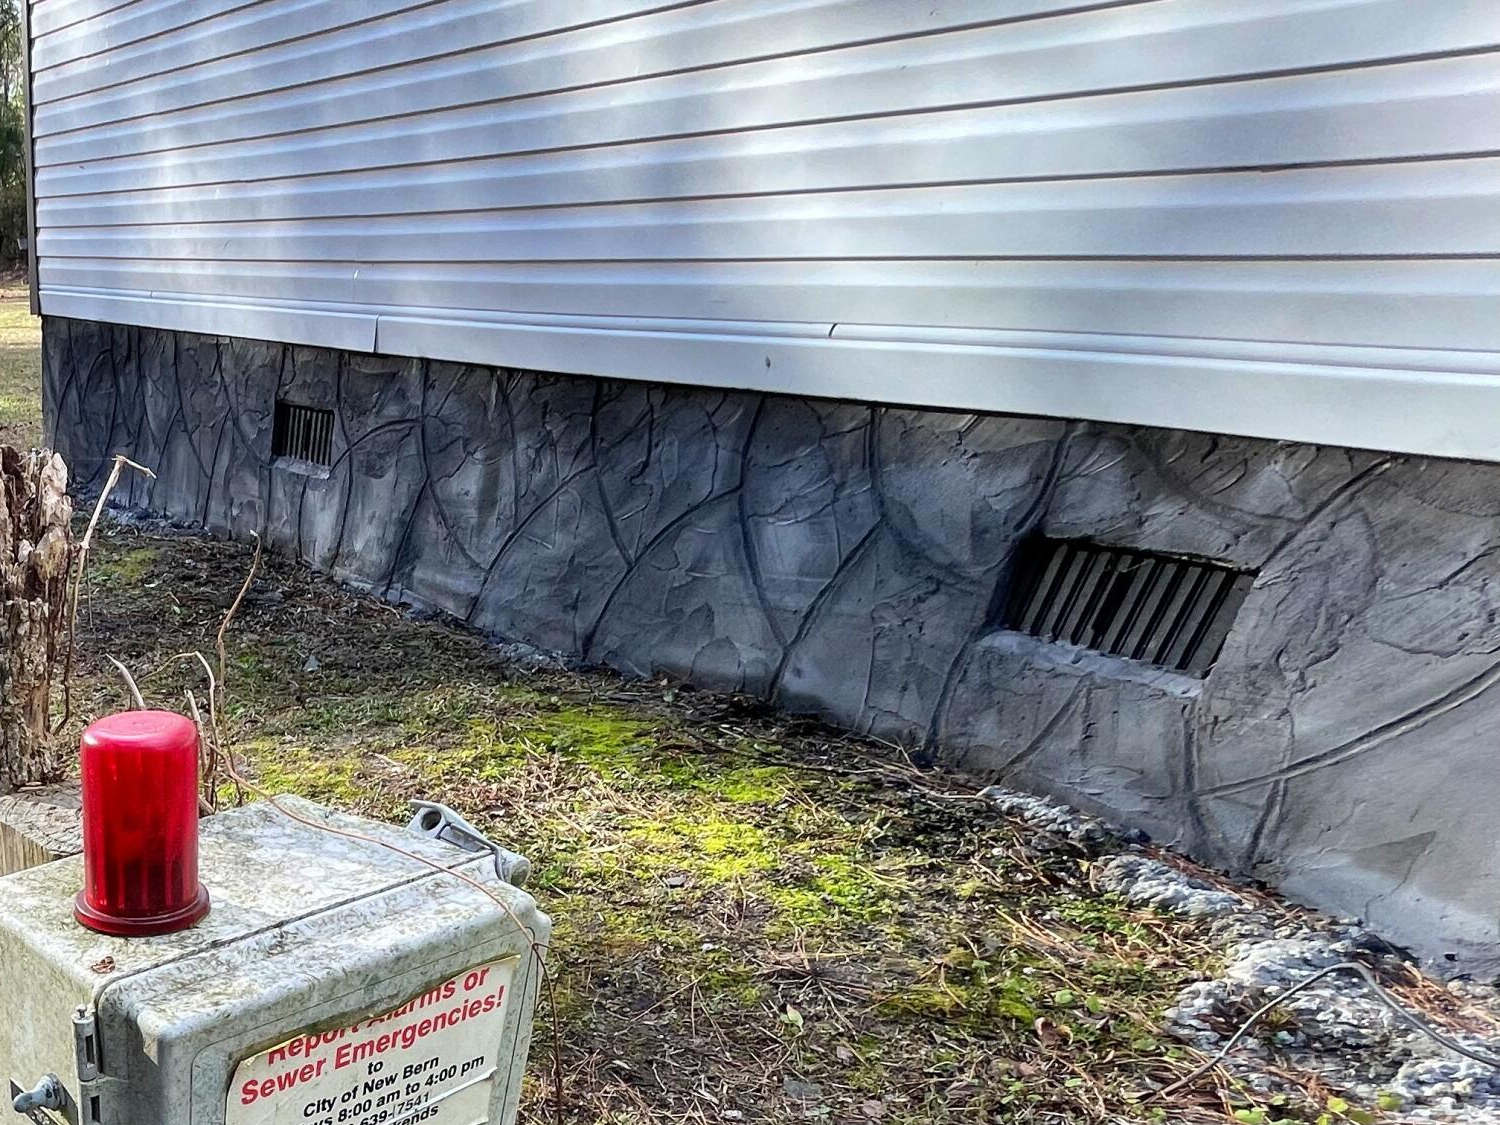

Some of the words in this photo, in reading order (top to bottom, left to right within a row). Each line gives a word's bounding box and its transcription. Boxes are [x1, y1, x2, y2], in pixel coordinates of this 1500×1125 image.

[464, 967, 490, 992] or
[241, 1058, 327, 1105] Sewer
[334, 985, 505, 1070] Emergencies!
[367, 1061, 384, 1075] to
[303, 1096, 337, 1118] City
[341, 1085, 359, 1103] of
[363, 1073, 398, 1095] New
[402, 1057, 439, 1080] Bern
[338, 1098, 372, 1122] 8:00
[376, 1089, 400, 1107] am
[405, 1080, 420, 1096] to
[424, 1065, 457, 1087] 4:00
[460, 1056, 485, 1077] pm
